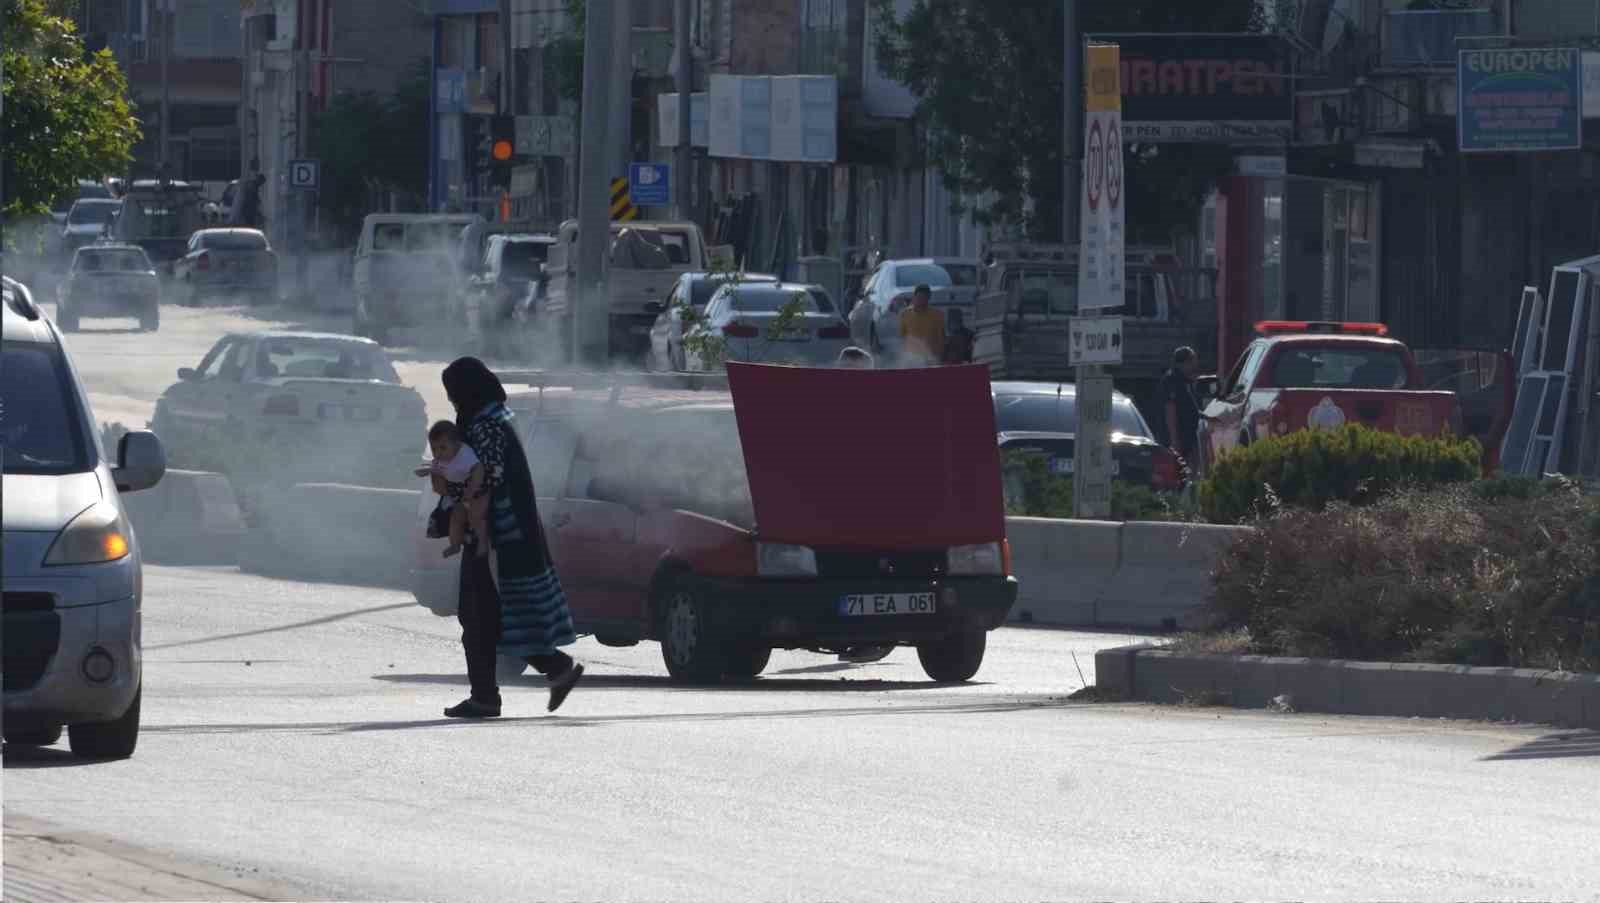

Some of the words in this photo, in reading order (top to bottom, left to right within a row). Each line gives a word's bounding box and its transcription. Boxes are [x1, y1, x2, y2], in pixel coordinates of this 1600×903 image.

[1466, 51, 1573, 72] EUROPEN
[297, 166, 311, 183] D
[847, 596, 864, 614] 71
[873, 595, 896, 613] EA
[908, 593, 935, 612] 061
